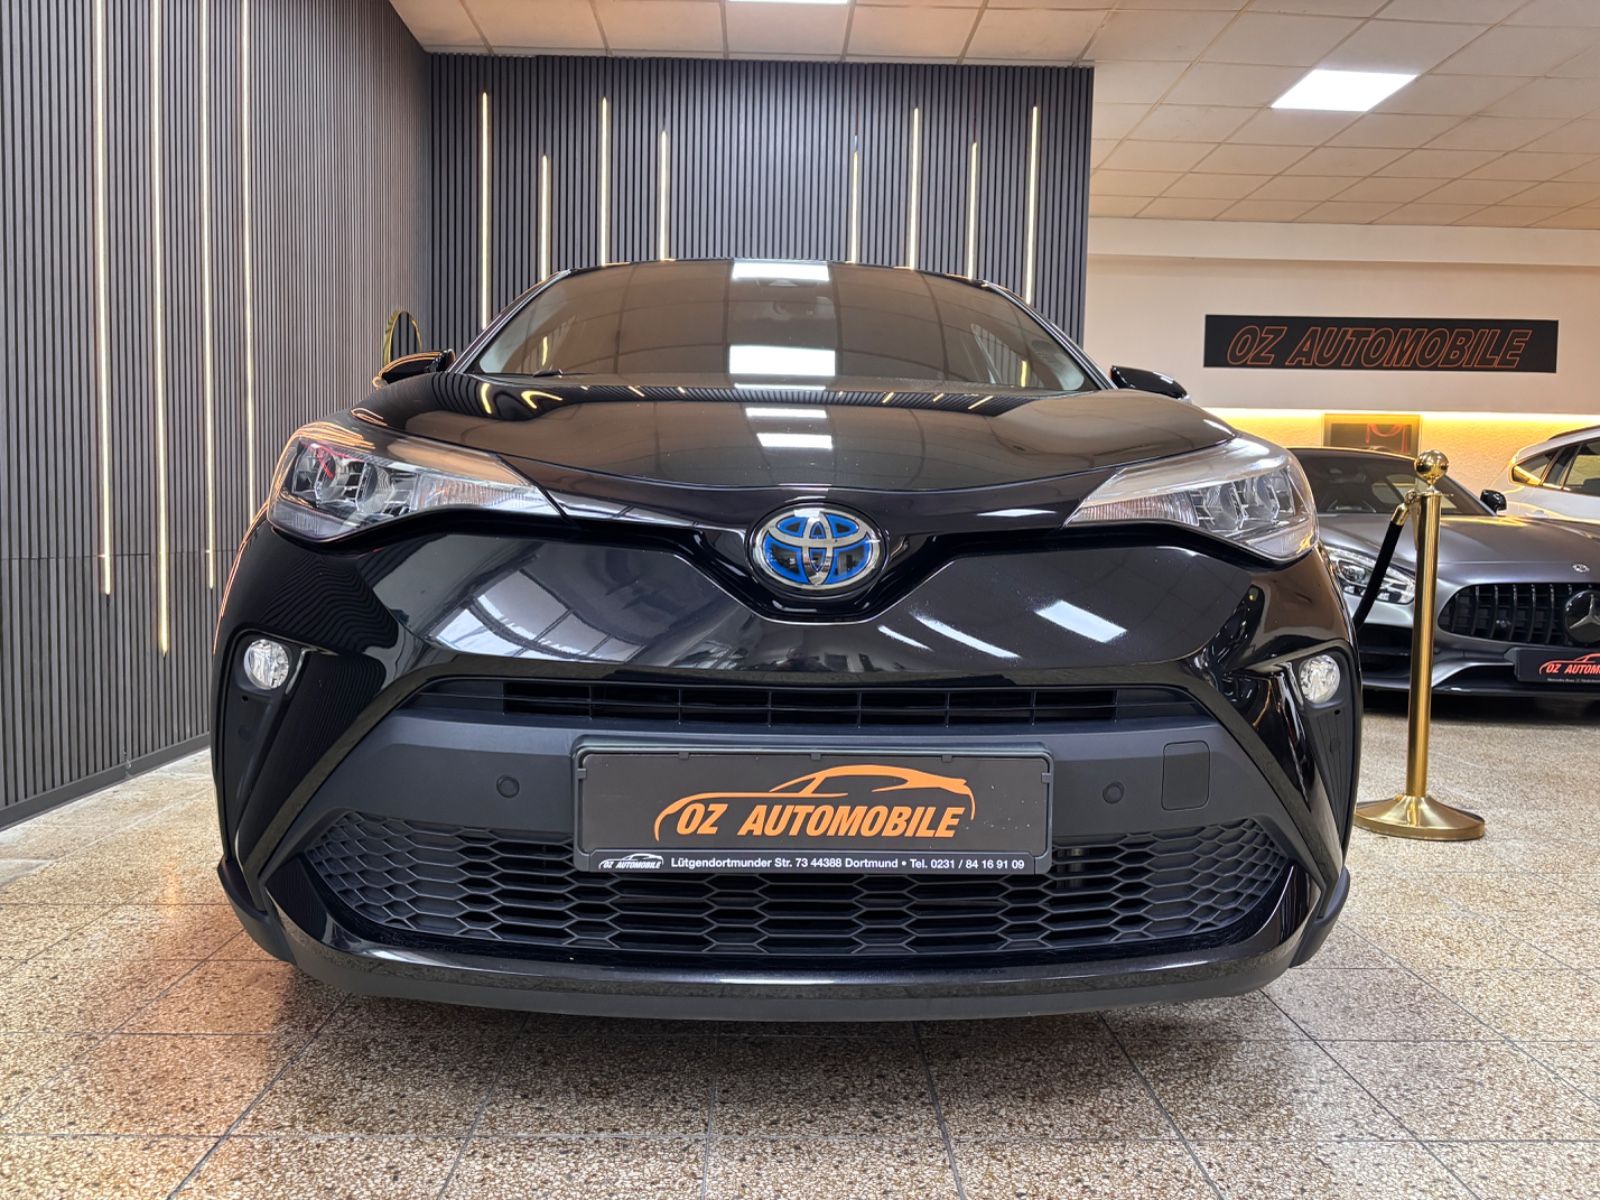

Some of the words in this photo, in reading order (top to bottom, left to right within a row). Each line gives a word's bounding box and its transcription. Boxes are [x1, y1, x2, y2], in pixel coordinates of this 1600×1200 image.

[1227, 325, 1288, 366] OZ
[1285, 327, 1533, 368] AUTOMOBILE
[1545, 663, 1561, 674] OZ
[676, 803, 728, 836] OZ
[736, 804, 966, 838] AUTOMOBILE
[603, 861, 613, 869] OZ
[615, 861, 662, 870] AUTOMOBILE
[670, 857, 772, 870] Lütgendortmunder
[774, 858, 793, 868] Str.
[795, 858, 809, 868] 73
[810, 858, 843, 868] 44388
[845, 858, 899, 868] Dortmund
[909, 858, 928, 869] Tel.
[930, 859, 955, 869] 0231
[965, 859, 979, 869] 84
[982, 859, 994, 869] 16
[996, 859, 1008, 869] 91
[1011, 859, 1025, 870] 09
